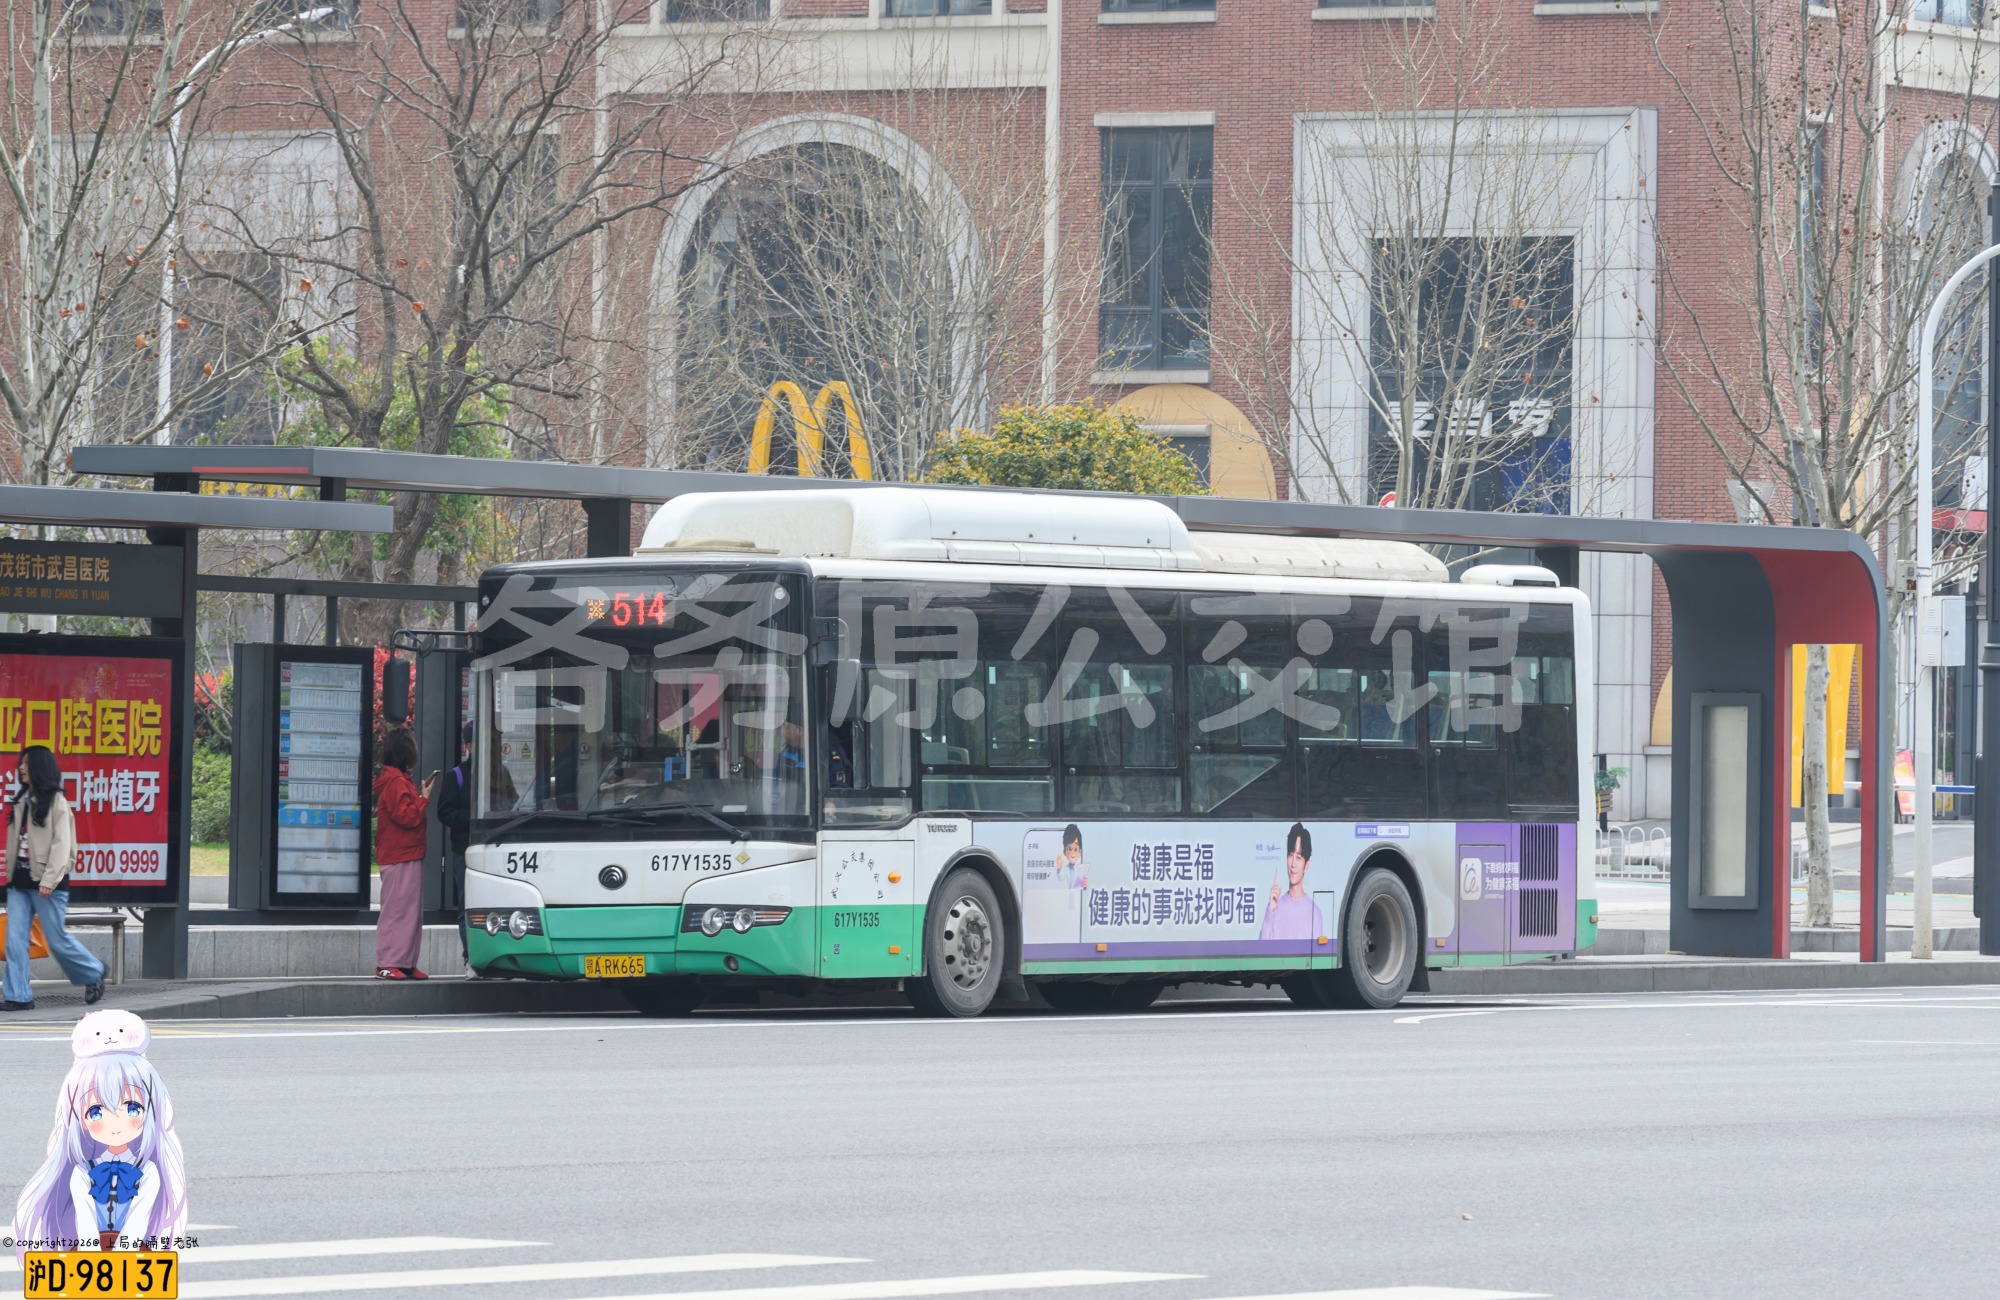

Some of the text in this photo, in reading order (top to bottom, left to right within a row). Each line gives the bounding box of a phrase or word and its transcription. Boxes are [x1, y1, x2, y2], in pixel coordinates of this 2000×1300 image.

[26, 587, 37, 598] SHI
[41, 588, 52, 599] WU
[55, 588, 79, 600] CHANG
[82, 590, 88, 600] YI
[91, 590, 110, 601] YUAN
[612, 592, 667, 626] 514
[75, 850, 159, 874] 8700 9999
[507, 852, 538, 874] 514
[651, 854, 732, 872] 617Y1535
[1131, 843, 1214, 881] 健康是福
[1089, 887, 1255, 926] 健康的事就找阿福
[834, 912, 880, 927] 617Y1535
